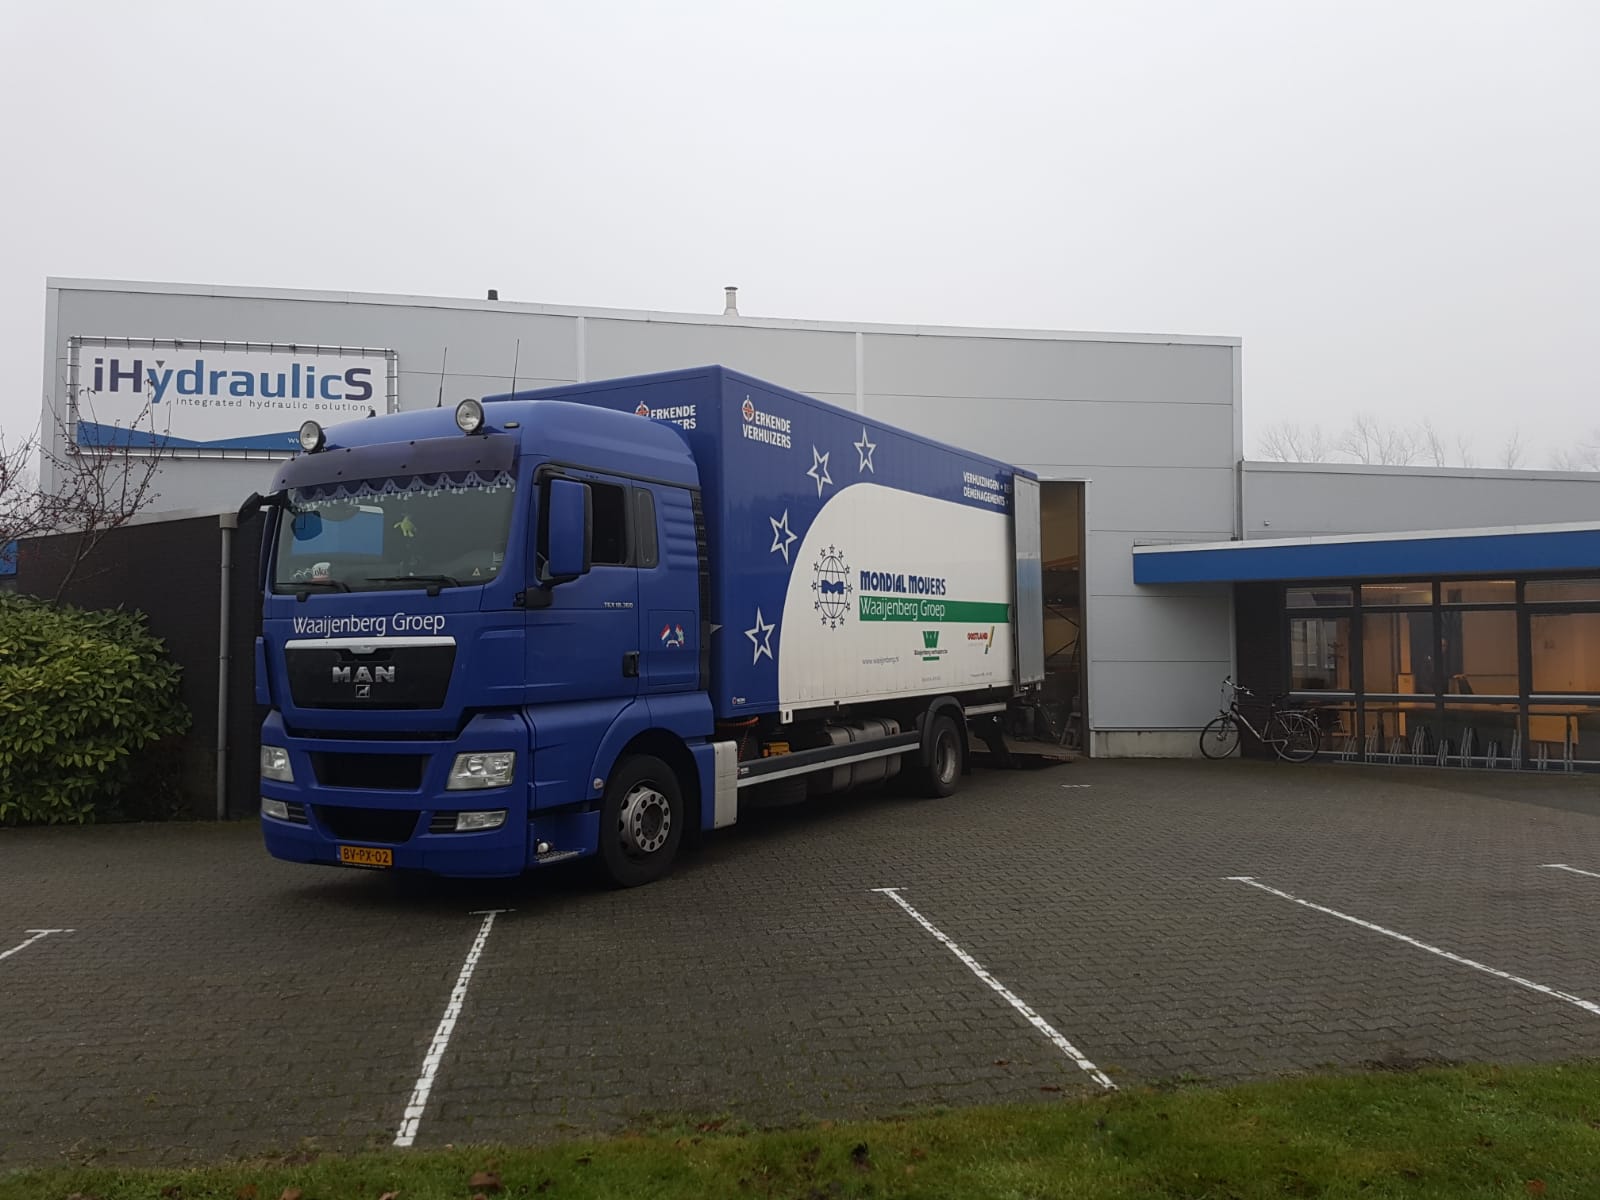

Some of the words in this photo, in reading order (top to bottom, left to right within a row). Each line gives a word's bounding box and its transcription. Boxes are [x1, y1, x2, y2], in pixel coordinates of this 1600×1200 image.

[95, 358, 373, 404] iHydraulicS
[176, 398, 242, 408] integrated
[250, 400, 308, 410] hydraulic
[315, 403, 373, 412] solutions
[651, 405, 696, 420] ERKENDE
[756, 411, 791, 434] ERKENDE
[743, 424, 791, 449] VERHUIZERS
[860, 570, 907, 594] MONDIAL
[860, 597, 918, 621] Waaijenberg
[920, 600, 945, 621] Groep
[293, 615, 386, 638] Waaijenberg
[392, 612, 445, 635] Groep
[332, 666, 395, 683] MAN
[343, 847, 389, 863] BV-PX-02
